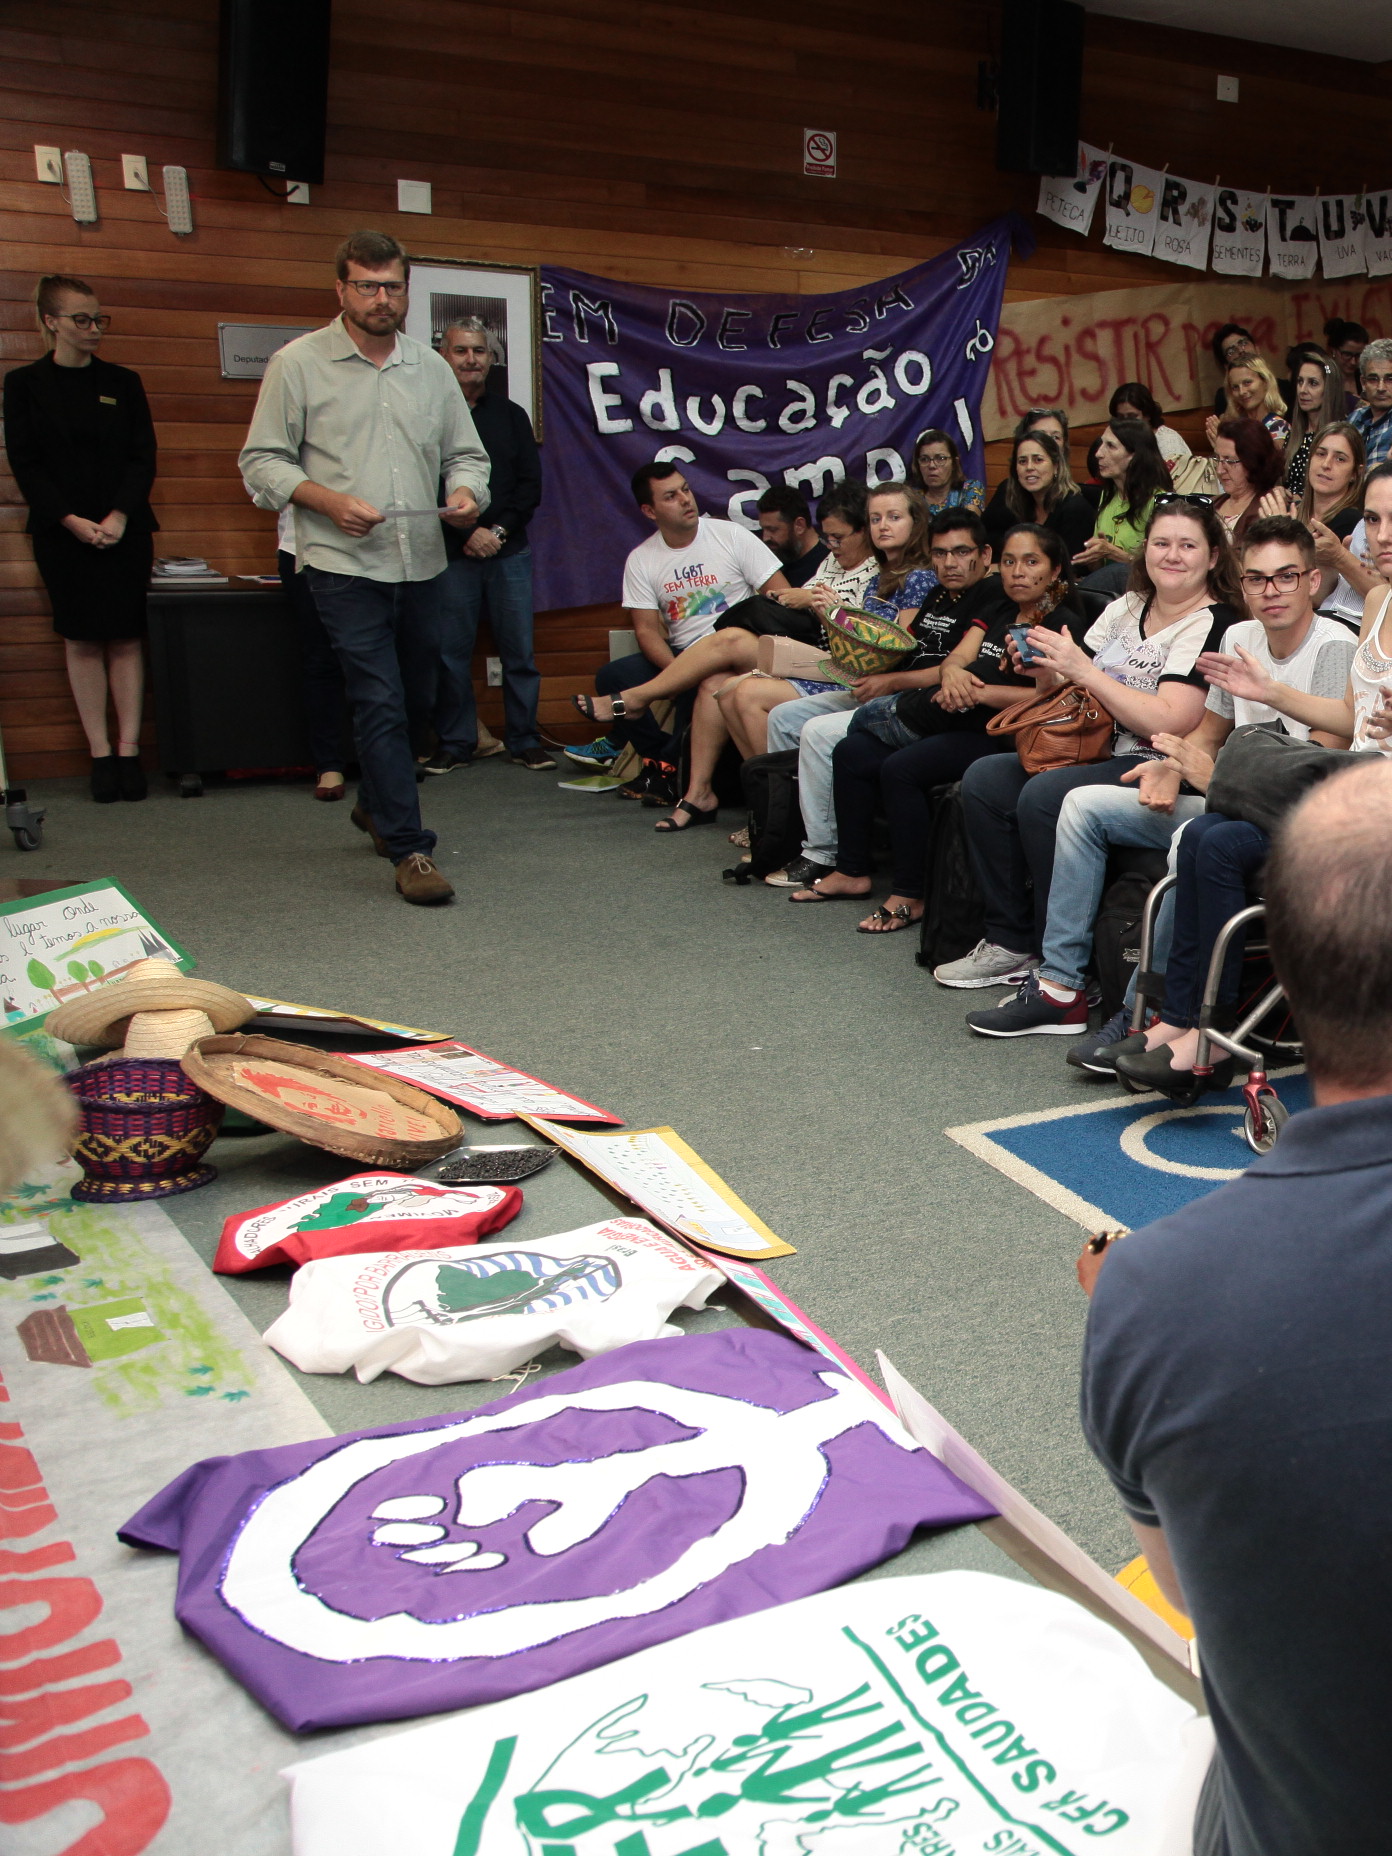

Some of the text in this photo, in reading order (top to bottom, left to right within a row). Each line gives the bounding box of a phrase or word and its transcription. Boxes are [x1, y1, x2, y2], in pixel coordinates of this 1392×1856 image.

[1046, 192, 1085, 222] PETECA
[1109, 162, 1133, 217] Q
[1160, 178, 1187, 227] R
[1217, 190, 1238, 233] S
[1271, 199, 1295, 242] T
[1322, 199, 1345, 241] U
[1365, 196, 1388, 238] V
[1165, 235, 1191, 255] ROSA
[1214, 244, 1261, 263] SEMENTES
[1278, 253, 1305, 268] TERRA
[1338, 244, 1356, 259] UVA
[665, 284, 914, 350] DEFESA
[234, 355, 268, 364] Deputad
[586, 344, 932, 436] Educação
[664, 574, 718, 594] SEM TERRA
[674, 563, 704, 581] LGBT
[3, 916, 48, 945] lugar
[885, 1613, 1130, 1837] CFR SAUDADES
